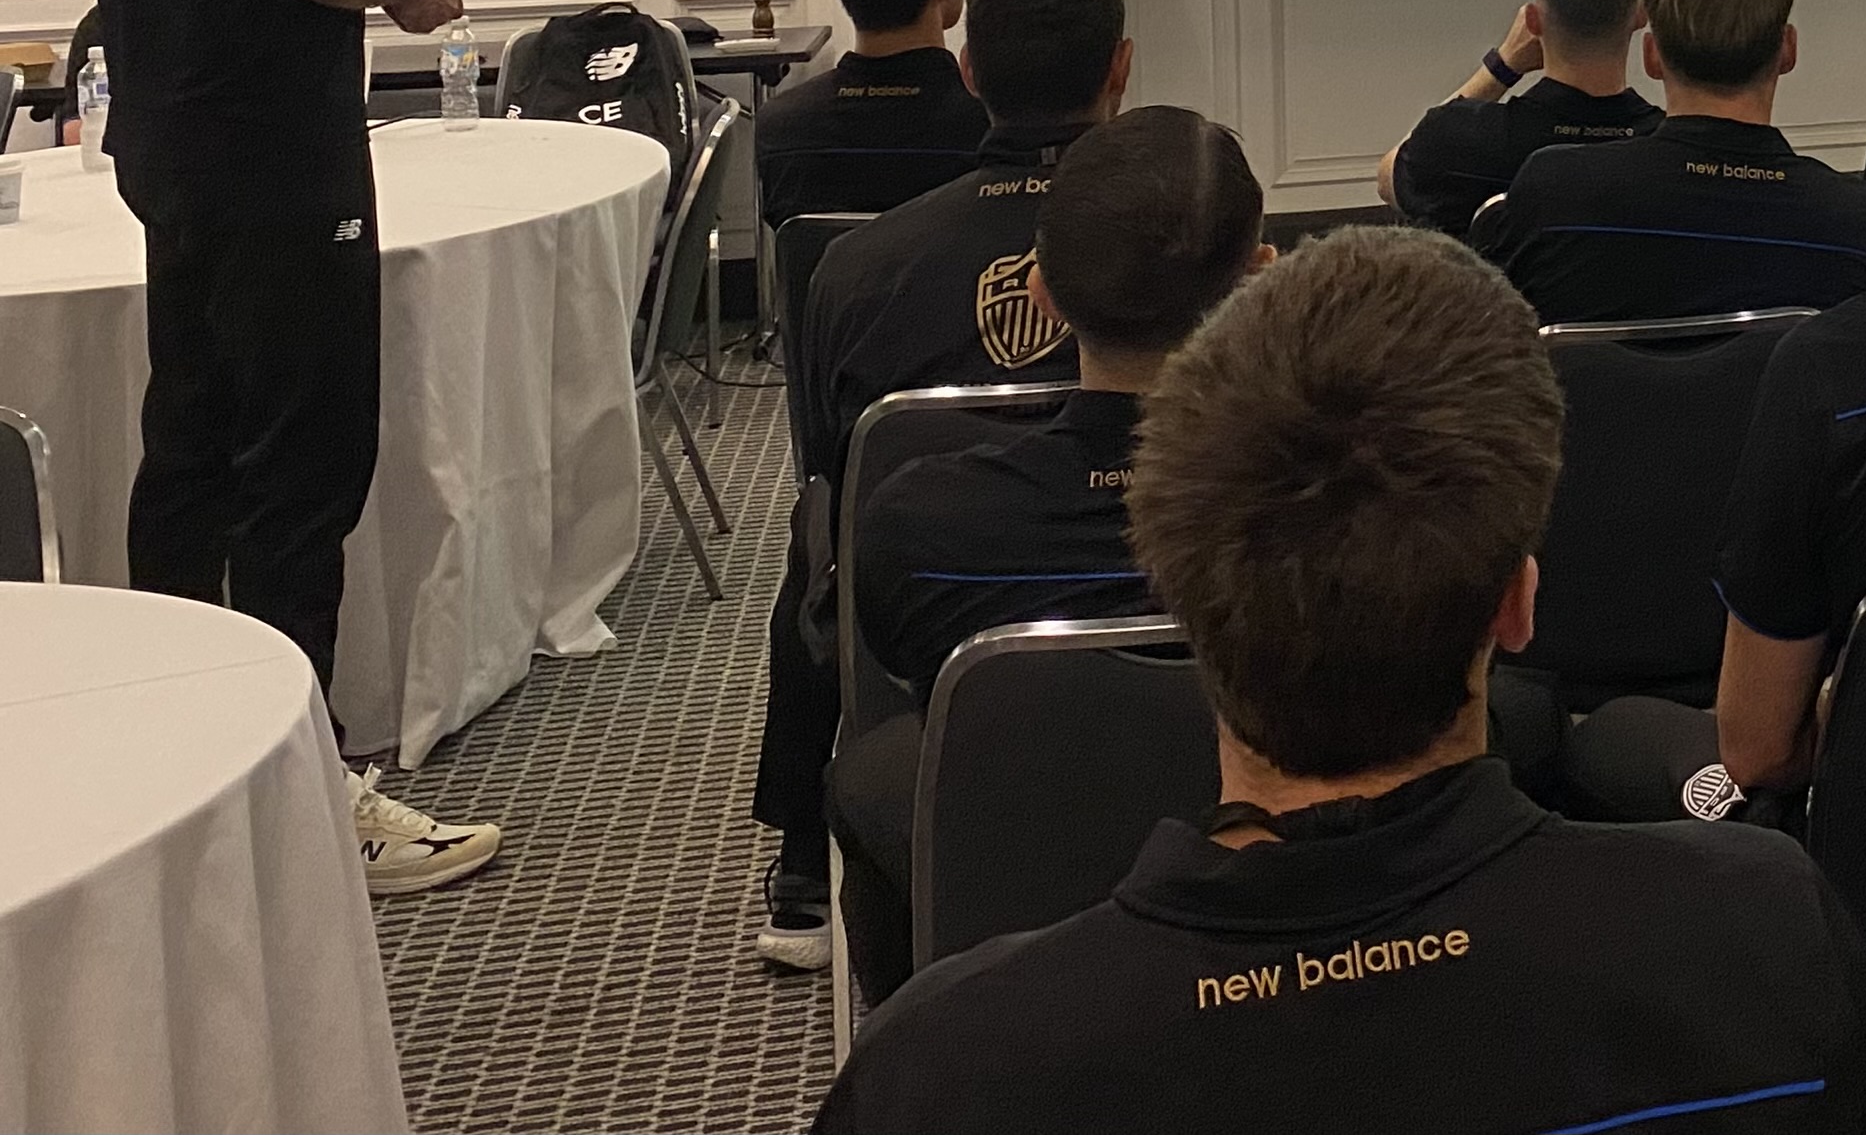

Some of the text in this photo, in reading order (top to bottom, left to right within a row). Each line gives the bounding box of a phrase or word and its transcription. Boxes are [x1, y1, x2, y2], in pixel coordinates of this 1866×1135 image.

[837, 84, 921, 97] new balance
[578, 100, 622, 125] CE
[1554, 123, 1635, 137] new balance
[1686, 160, 1786, 181] new balance
[978, 178, 1022, 198] new
[1197, 929, 1471, 1010] new balance
